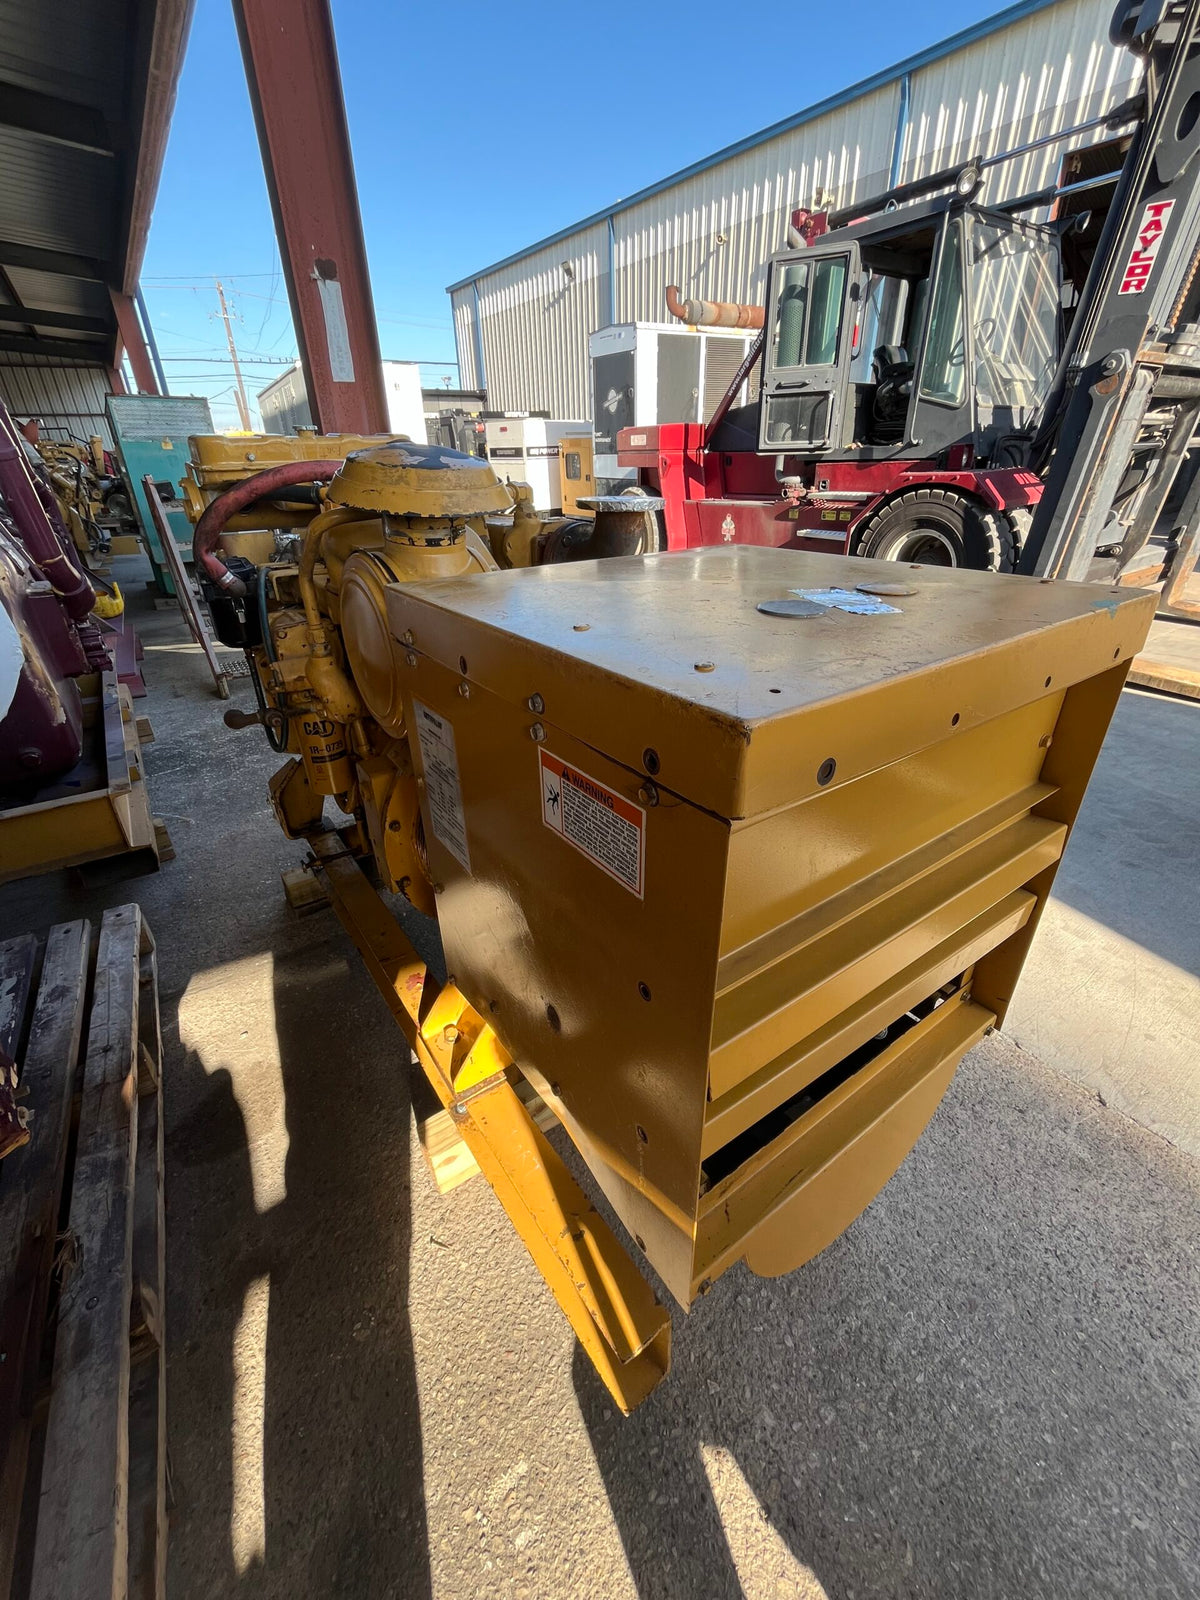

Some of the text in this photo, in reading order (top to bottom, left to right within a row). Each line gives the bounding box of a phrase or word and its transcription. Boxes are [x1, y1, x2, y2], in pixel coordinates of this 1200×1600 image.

[1120, 201, 1173, 293] TAYLOR
[727, 329, 764, 396] www.largelifttru
[303, 720, 335, 738] CAT
[571, 773, 614, 810] WARNING
